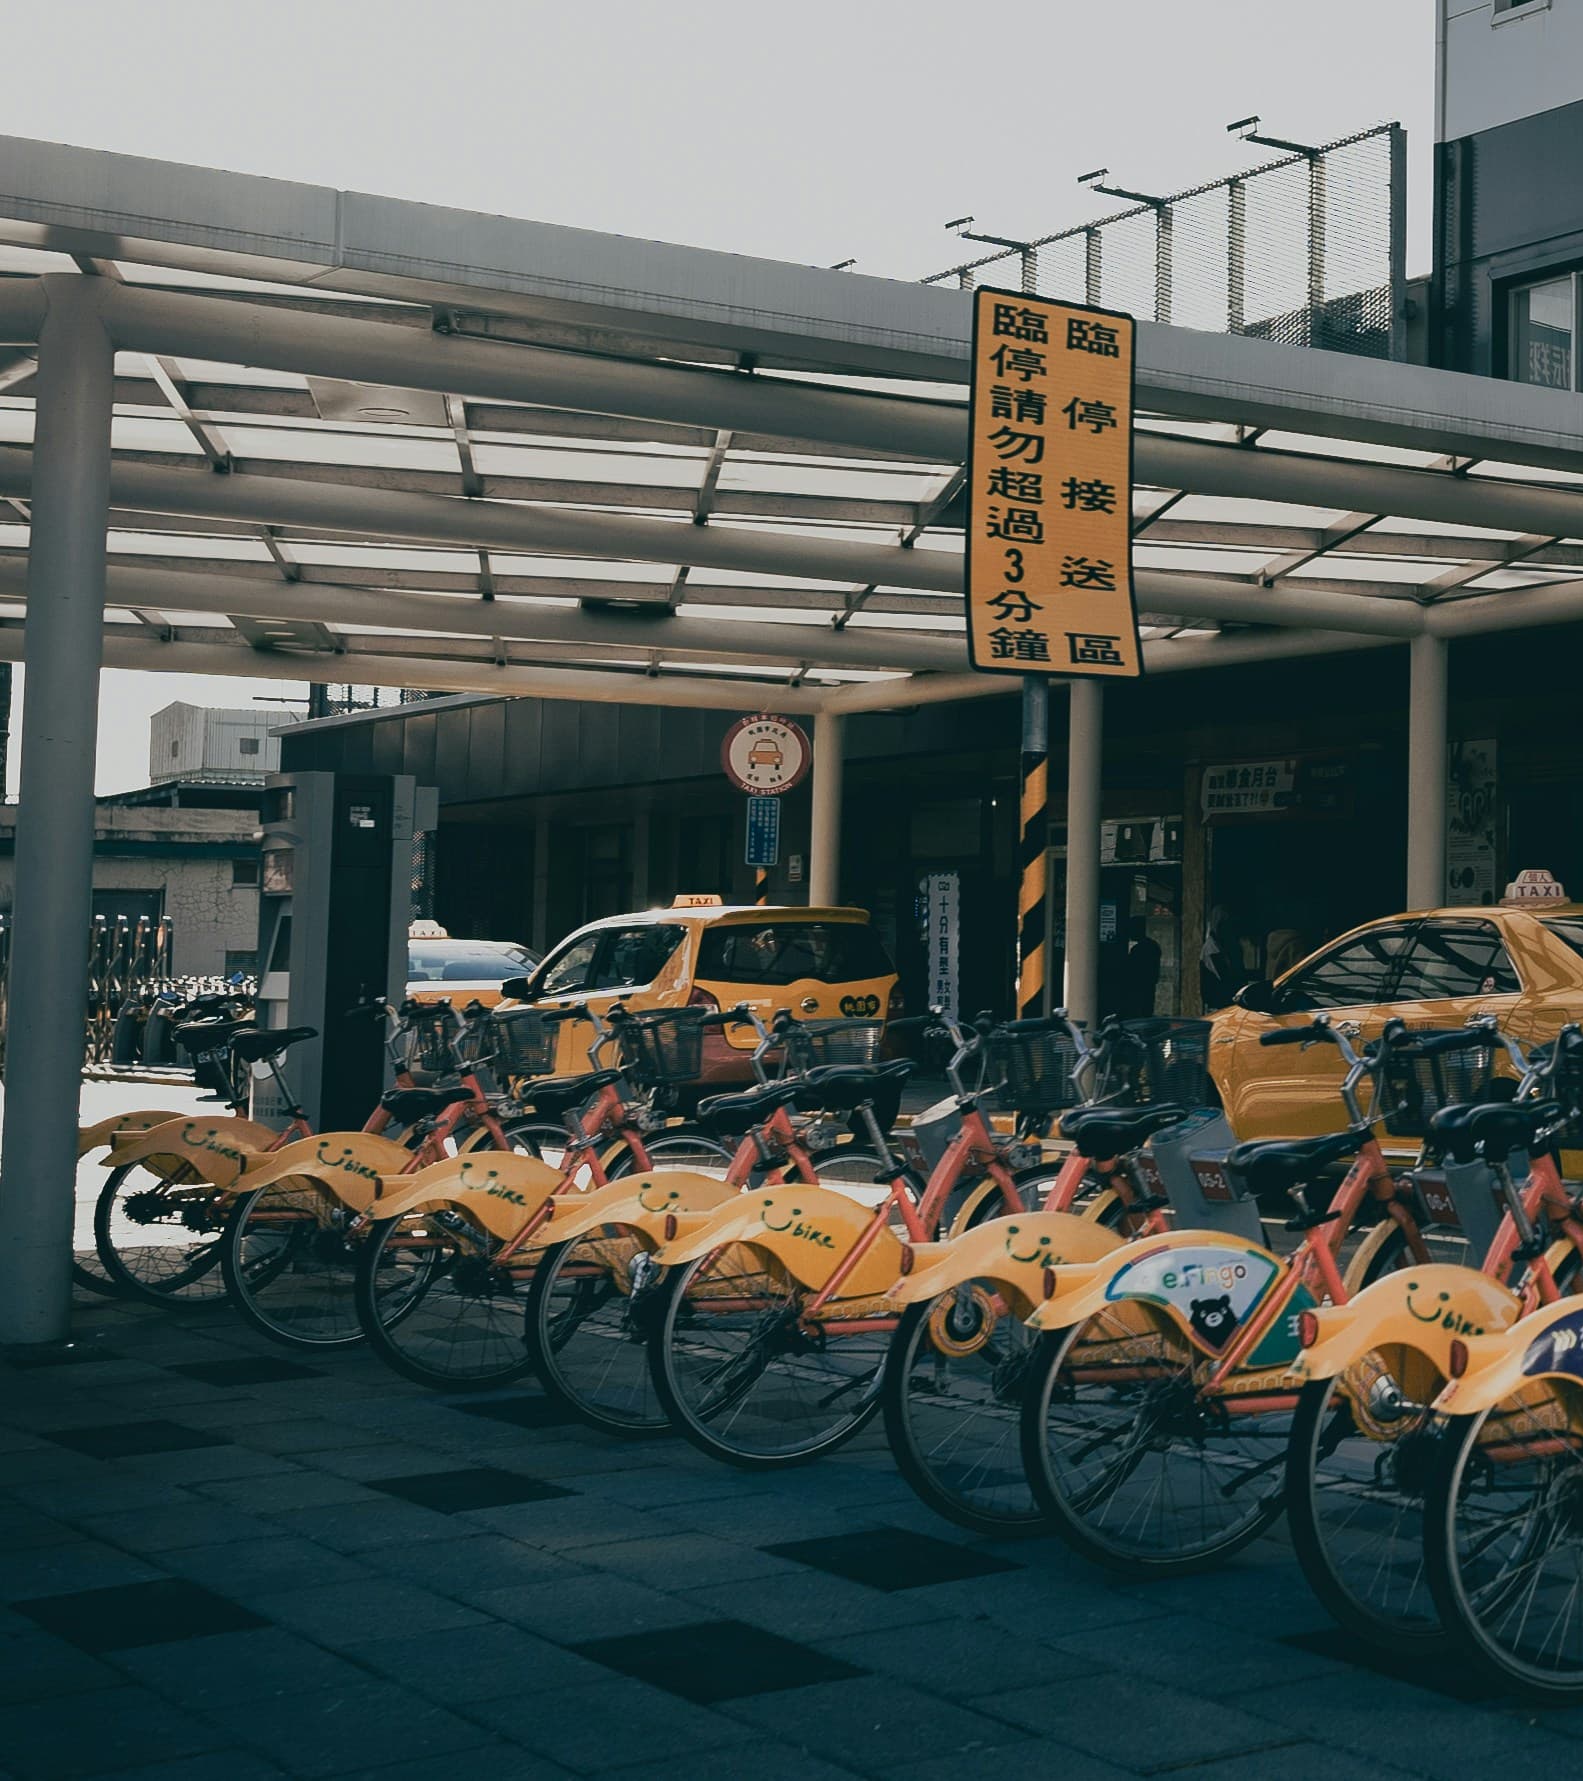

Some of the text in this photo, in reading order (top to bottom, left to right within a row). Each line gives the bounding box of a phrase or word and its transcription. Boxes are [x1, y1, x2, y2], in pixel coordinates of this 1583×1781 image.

[985, 303, 1051, 663] 臨停請勿超過3分鐘
[1059, 317, 1125, 667] 臨停接送區
[1518, 886, 1560, 897] TAXI
